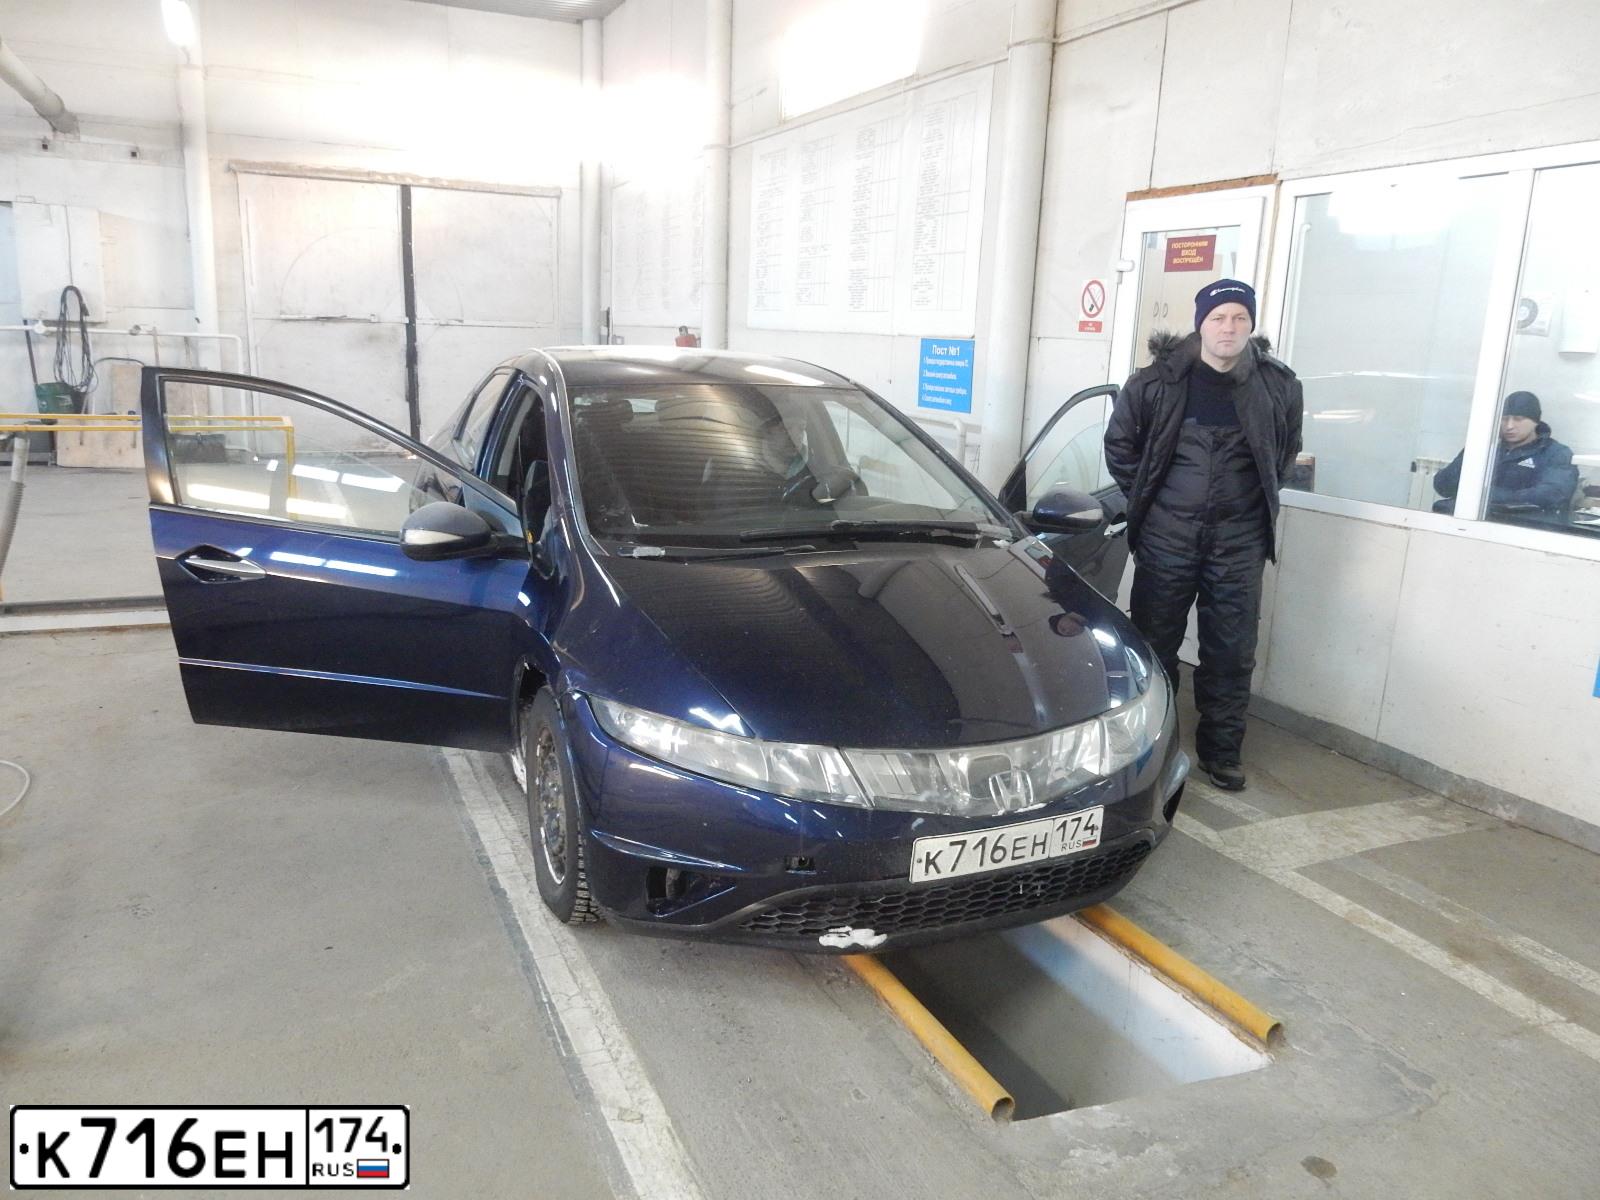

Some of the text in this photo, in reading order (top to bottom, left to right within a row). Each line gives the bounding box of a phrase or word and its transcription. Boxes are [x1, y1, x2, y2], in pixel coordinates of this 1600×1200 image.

[932, 344, 960, 356] Пост №1
[924, 812, 1096, 875] К716ЕН 174
[1061, 838, 1082, 852] RUS
